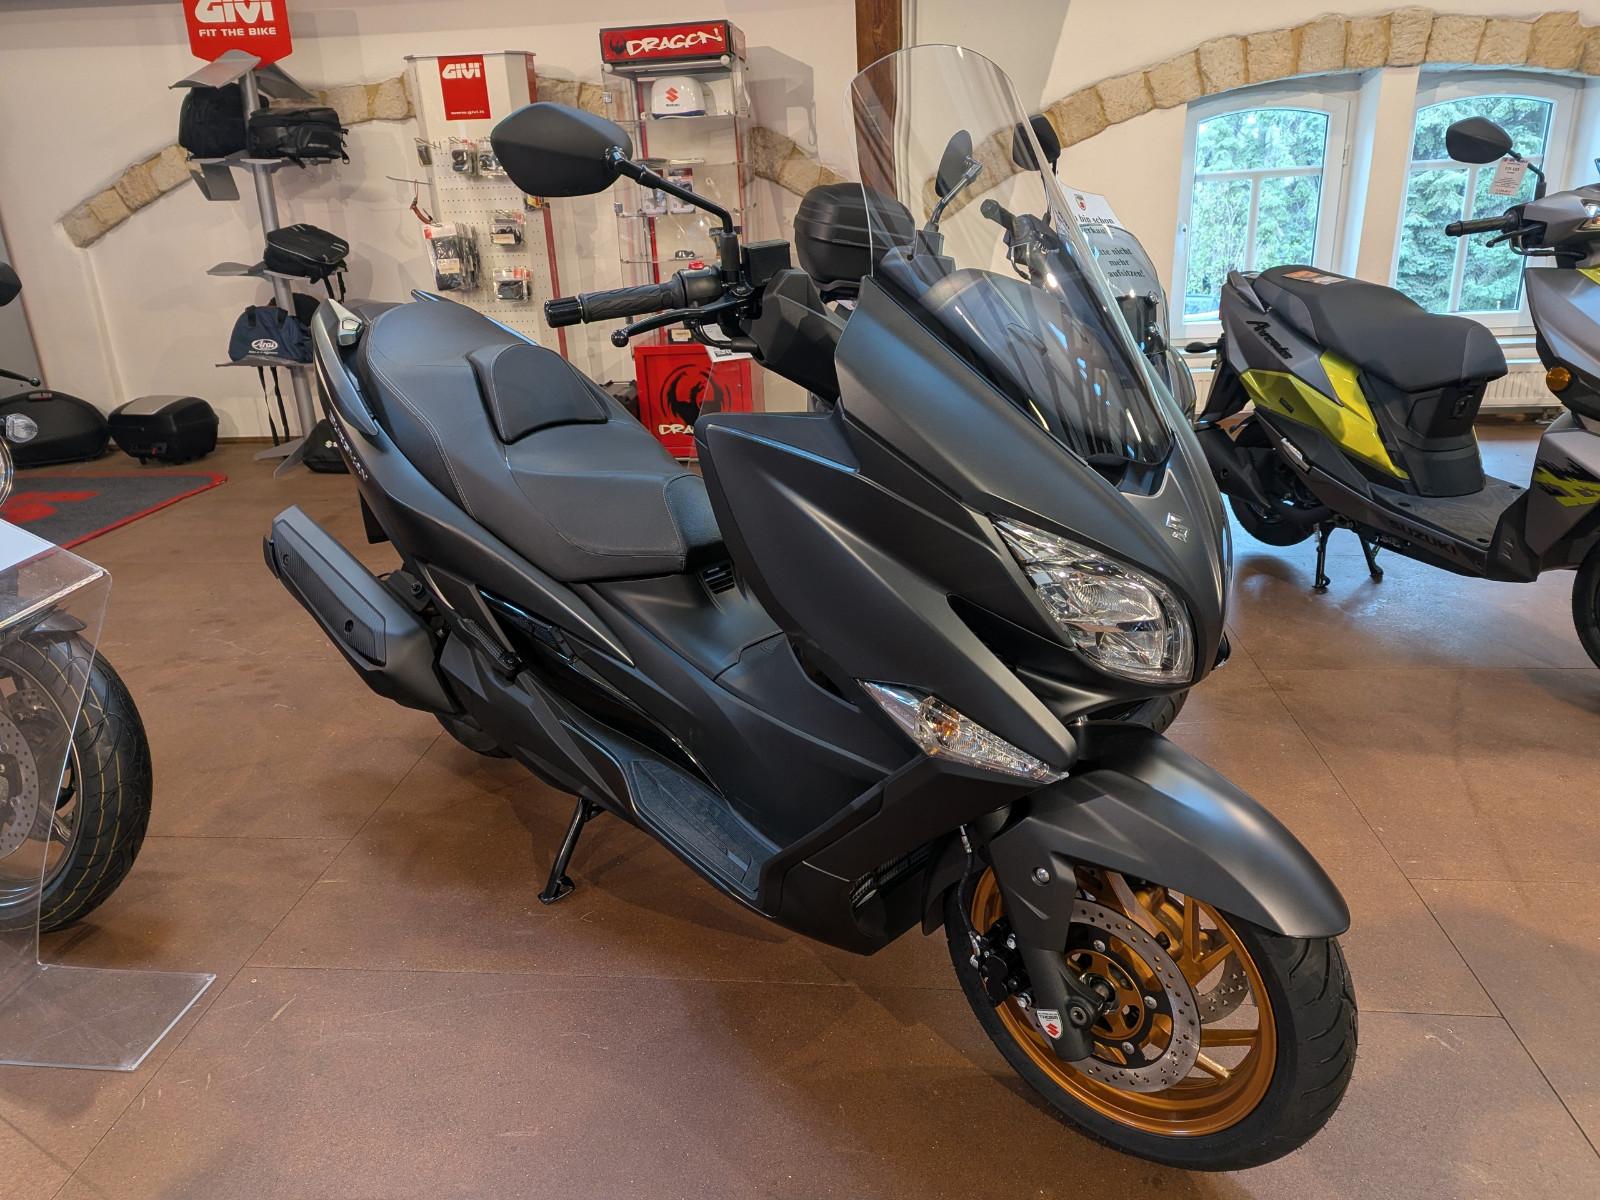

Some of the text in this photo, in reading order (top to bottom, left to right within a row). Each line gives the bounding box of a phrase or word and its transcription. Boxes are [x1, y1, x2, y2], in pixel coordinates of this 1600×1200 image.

[195, 0, 274, 23] GIVI
[199, 27, 277, 37] FIT THE BIKE
[626, 28, 722, 56] DRAGON
[442, 62, 481, 79] GIVI
[1092, 216, 1114, 224] schon
[1111, 247, 1132, 256] nicht
